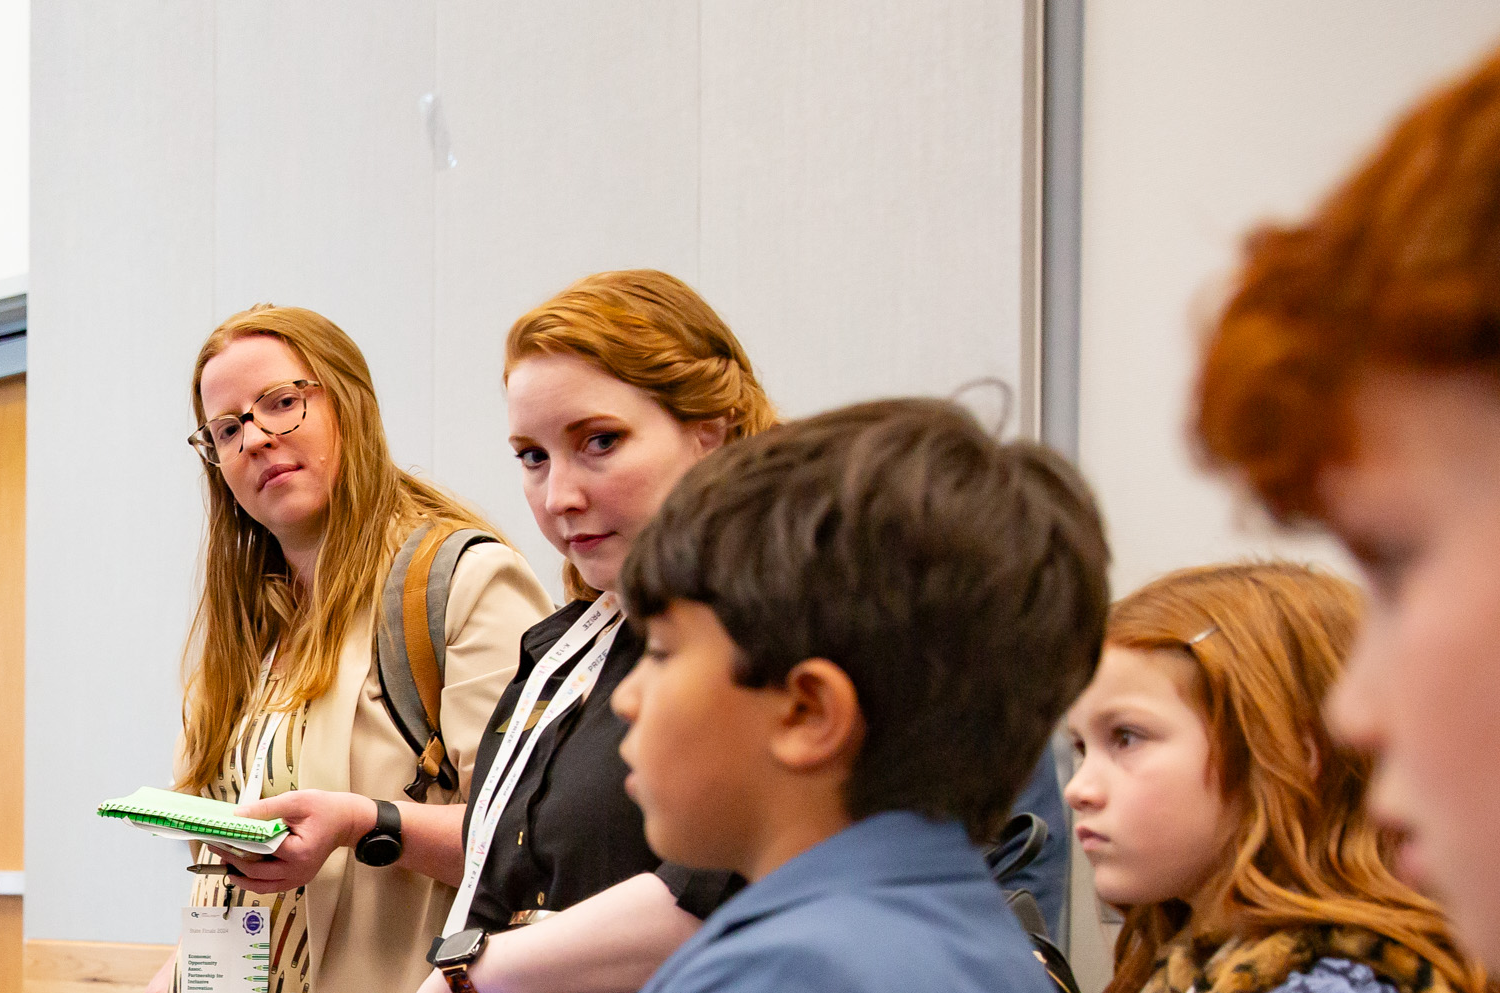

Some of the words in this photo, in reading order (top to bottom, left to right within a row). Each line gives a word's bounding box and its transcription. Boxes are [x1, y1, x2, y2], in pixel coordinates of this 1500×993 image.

[581, 610, 602, 632] PRIZE
[555, 642, 571, 656] K-12
[587, 648, 609, 673] PRIZE
